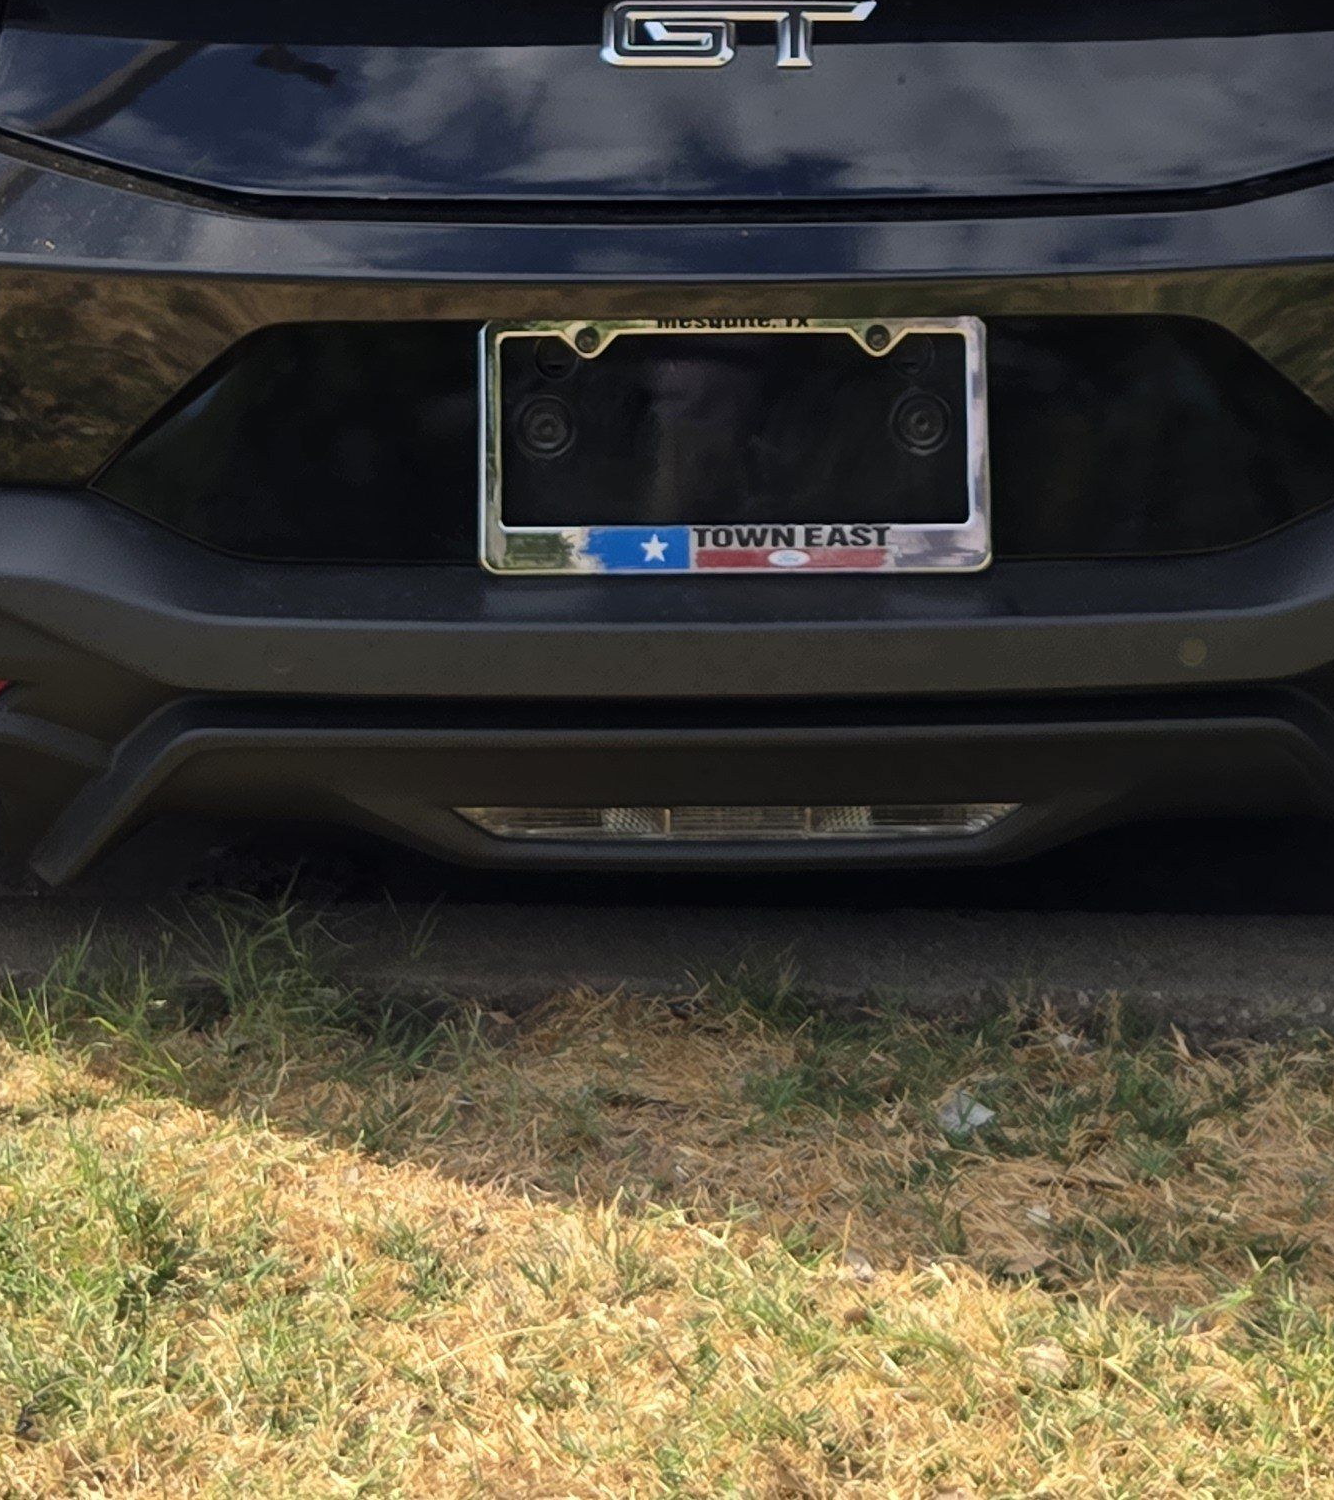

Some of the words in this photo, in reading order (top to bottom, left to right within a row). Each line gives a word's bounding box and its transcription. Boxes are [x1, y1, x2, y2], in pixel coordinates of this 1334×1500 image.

[600, 0, 878, 68] GT
[693, 526, 795, 548] TOWN
[804, 526, 891, 547] EAST
